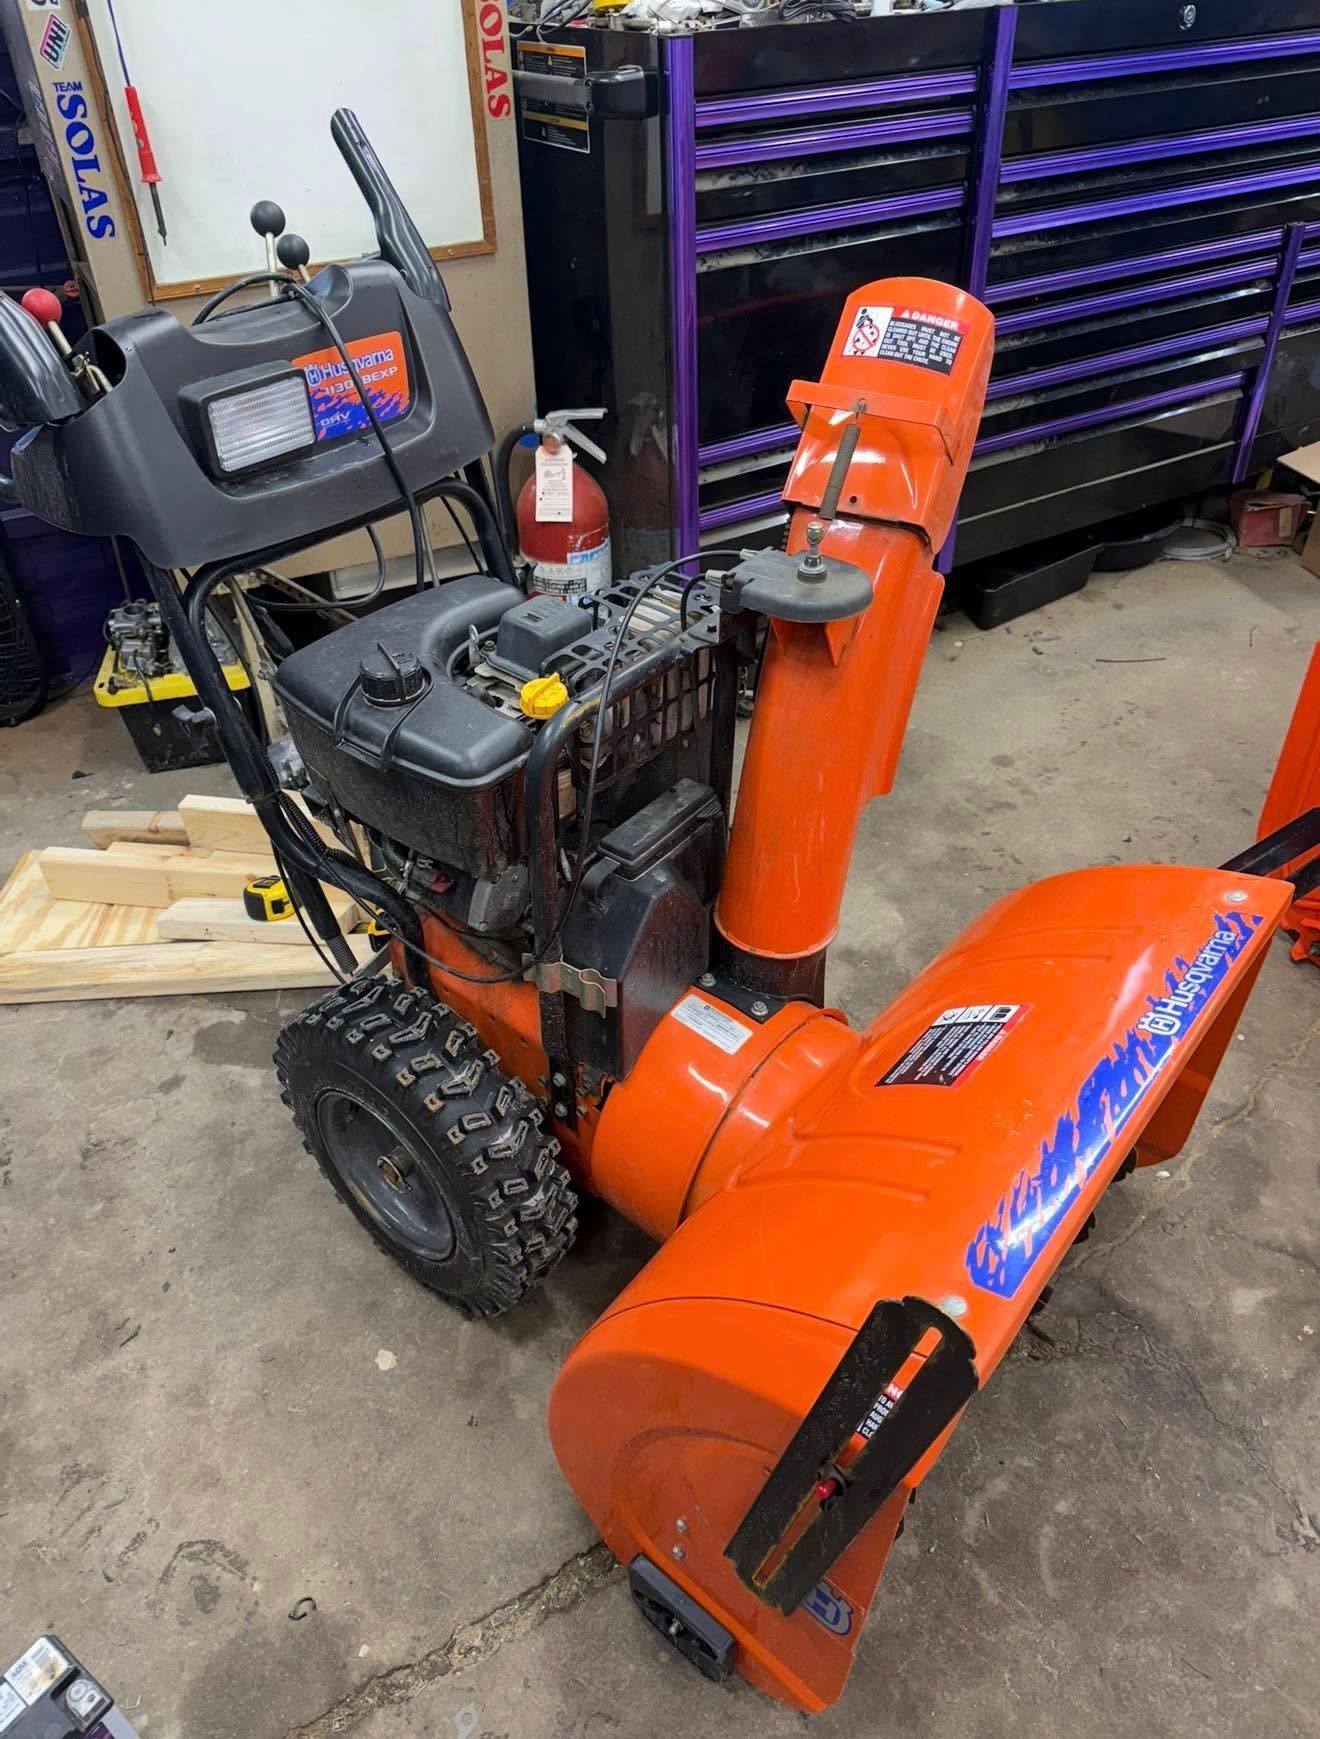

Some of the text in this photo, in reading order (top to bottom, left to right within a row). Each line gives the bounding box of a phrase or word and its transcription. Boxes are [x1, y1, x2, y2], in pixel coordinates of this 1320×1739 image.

[44, 20, 67, 63] UNI
[479, 0, 511, 118] OLAS
[52, 81, 83, 92] TEAM
[56, 93, 117, 240] SOLAS
[911, 311, 959, 330] DANGER
[323, 348, 394, 379] Husqvarna
[325, 366, 398, 396] 1130BEXP
[320, 411, 350, 426] OHV
[1160, 929, 1238, 1018] Husqvarna
